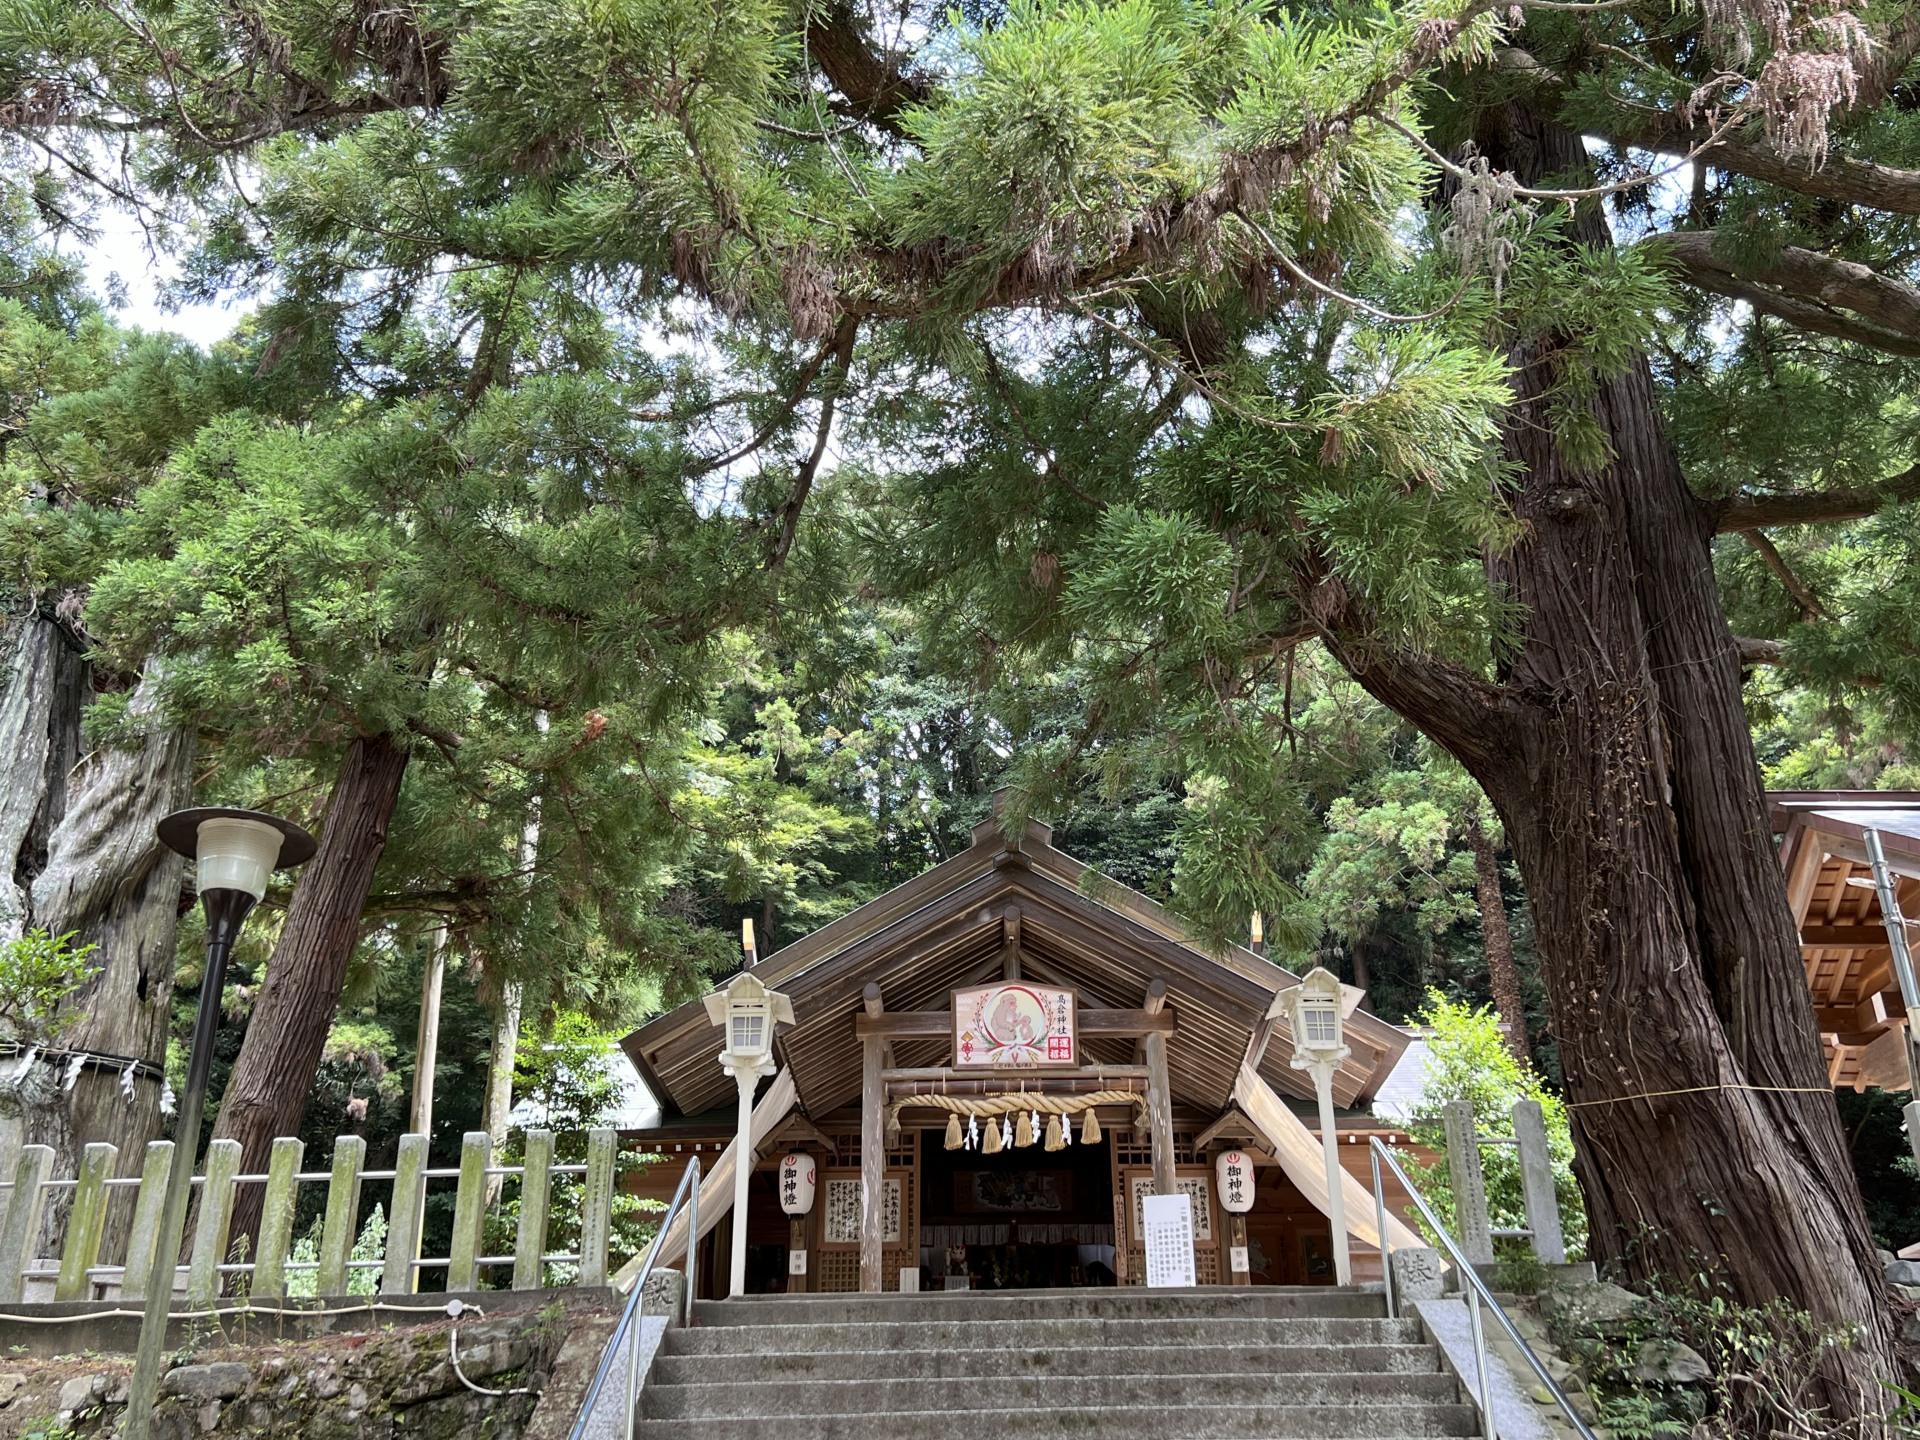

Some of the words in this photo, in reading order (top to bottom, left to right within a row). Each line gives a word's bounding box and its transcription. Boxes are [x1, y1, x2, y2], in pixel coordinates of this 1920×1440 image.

[783, 1168, 797, 1206] 御神燈
[1227, 1165, 1243, 1204] 御神燈
